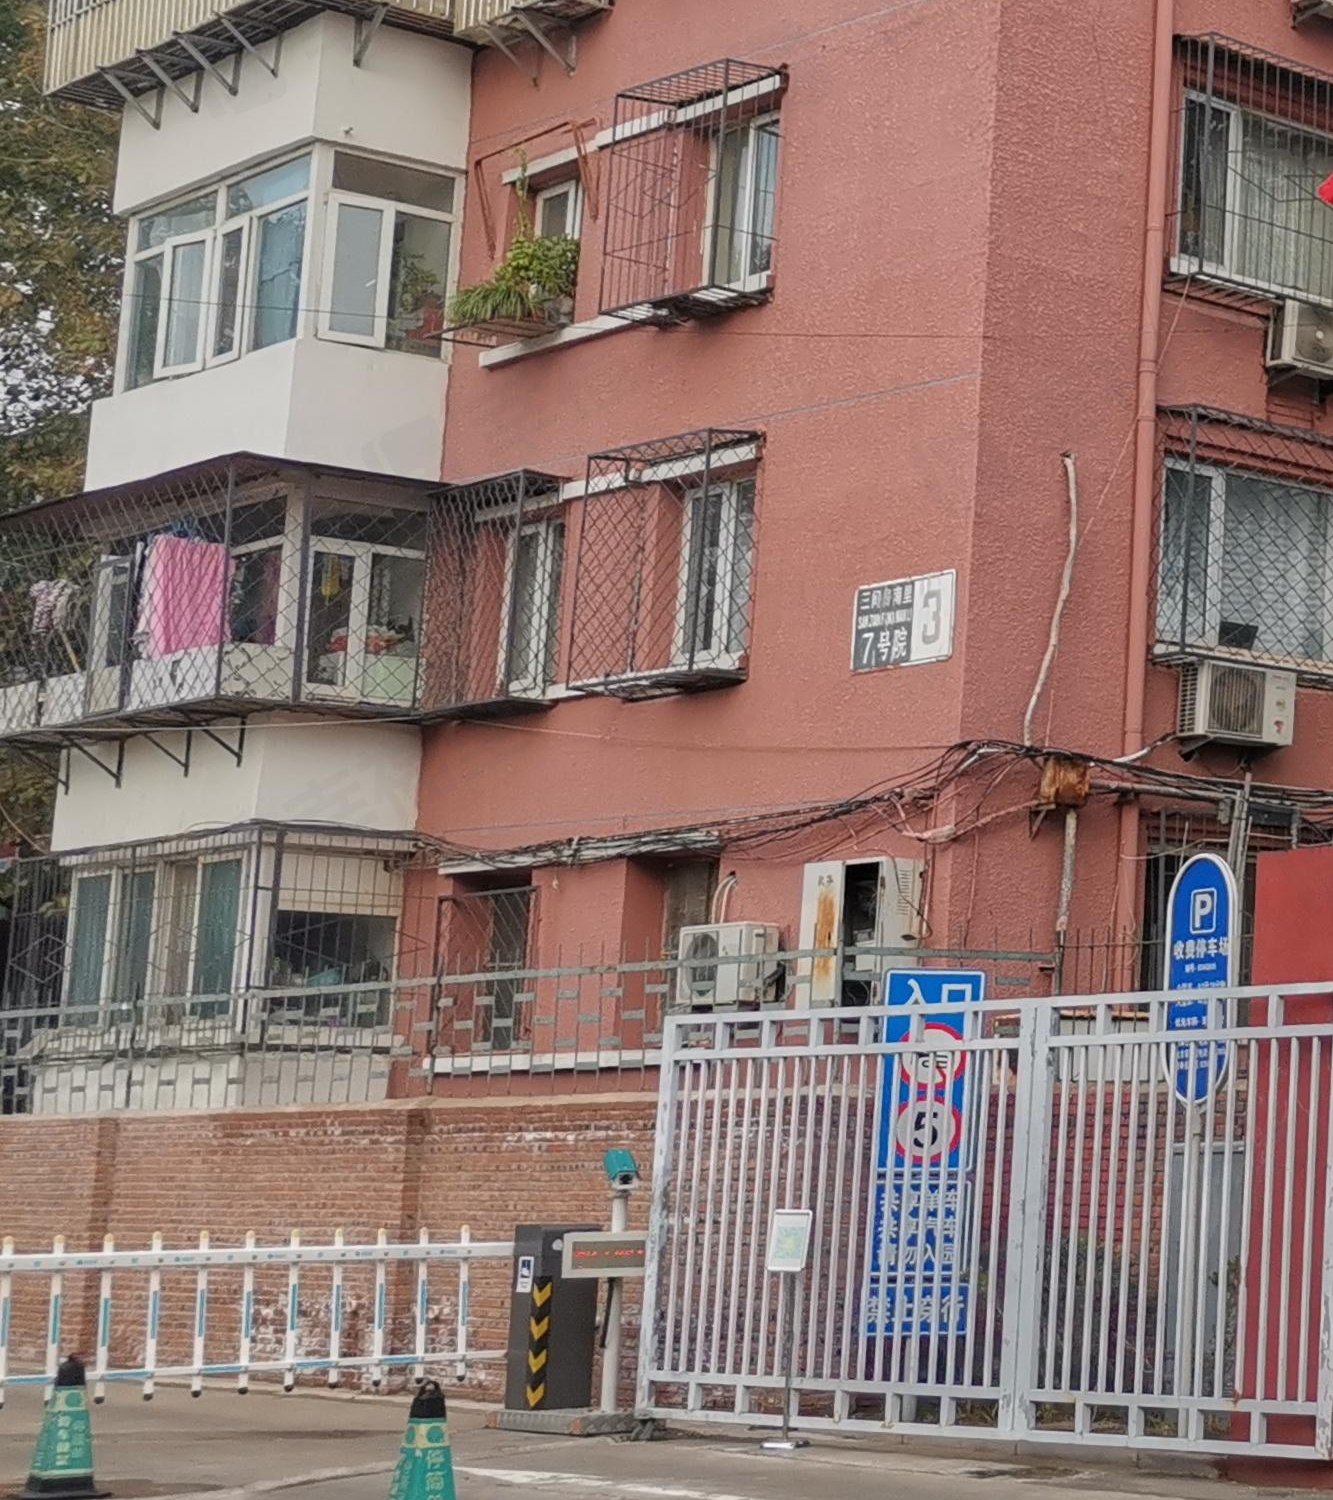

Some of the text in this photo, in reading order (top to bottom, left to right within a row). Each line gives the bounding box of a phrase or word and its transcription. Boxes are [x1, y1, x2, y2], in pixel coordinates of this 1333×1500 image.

[861, 626, 908, 665] 7号院
[1193, 891, 1213, 930] P
[911, 1110, 939, 1148] 5
